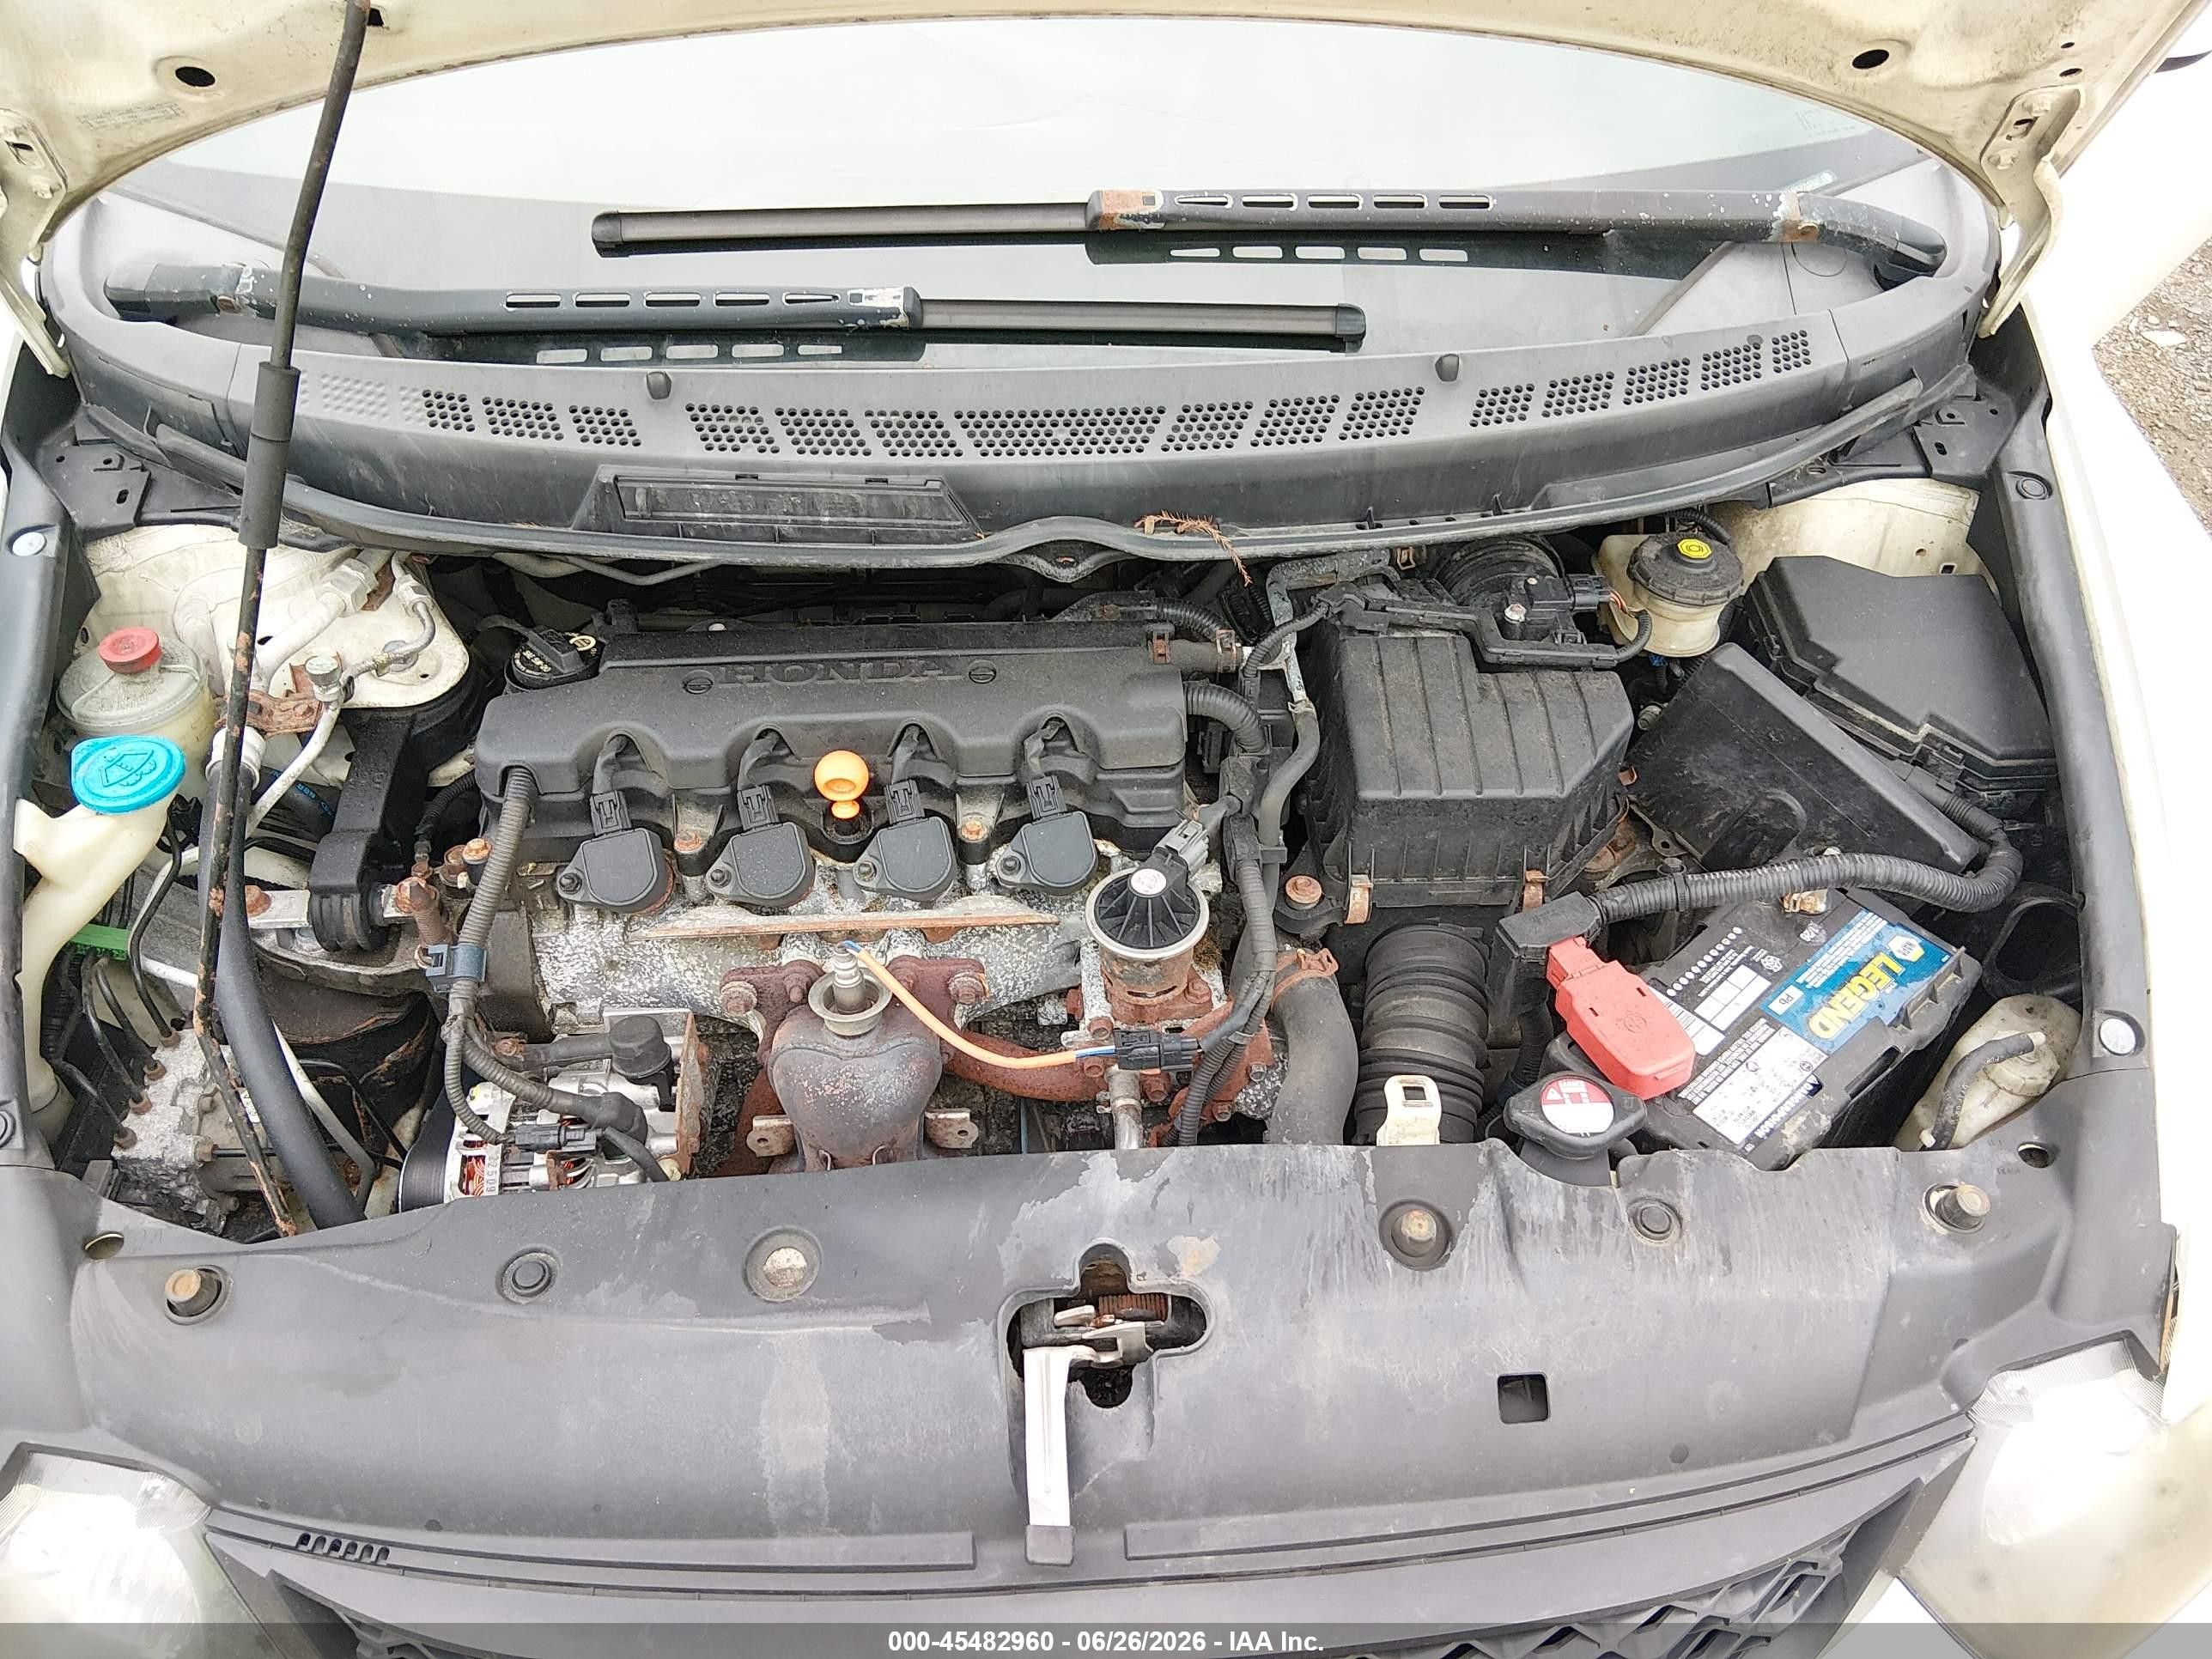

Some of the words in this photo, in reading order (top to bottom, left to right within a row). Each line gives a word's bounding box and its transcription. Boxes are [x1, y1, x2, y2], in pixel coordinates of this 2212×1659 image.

[717, 659, 964, 687] HONDA
[1900, 940, 1917, 957] NAPA
[1778, 993, 1795, 1005] Pb
[1808, 951, 1906, 1040] LEGEND
